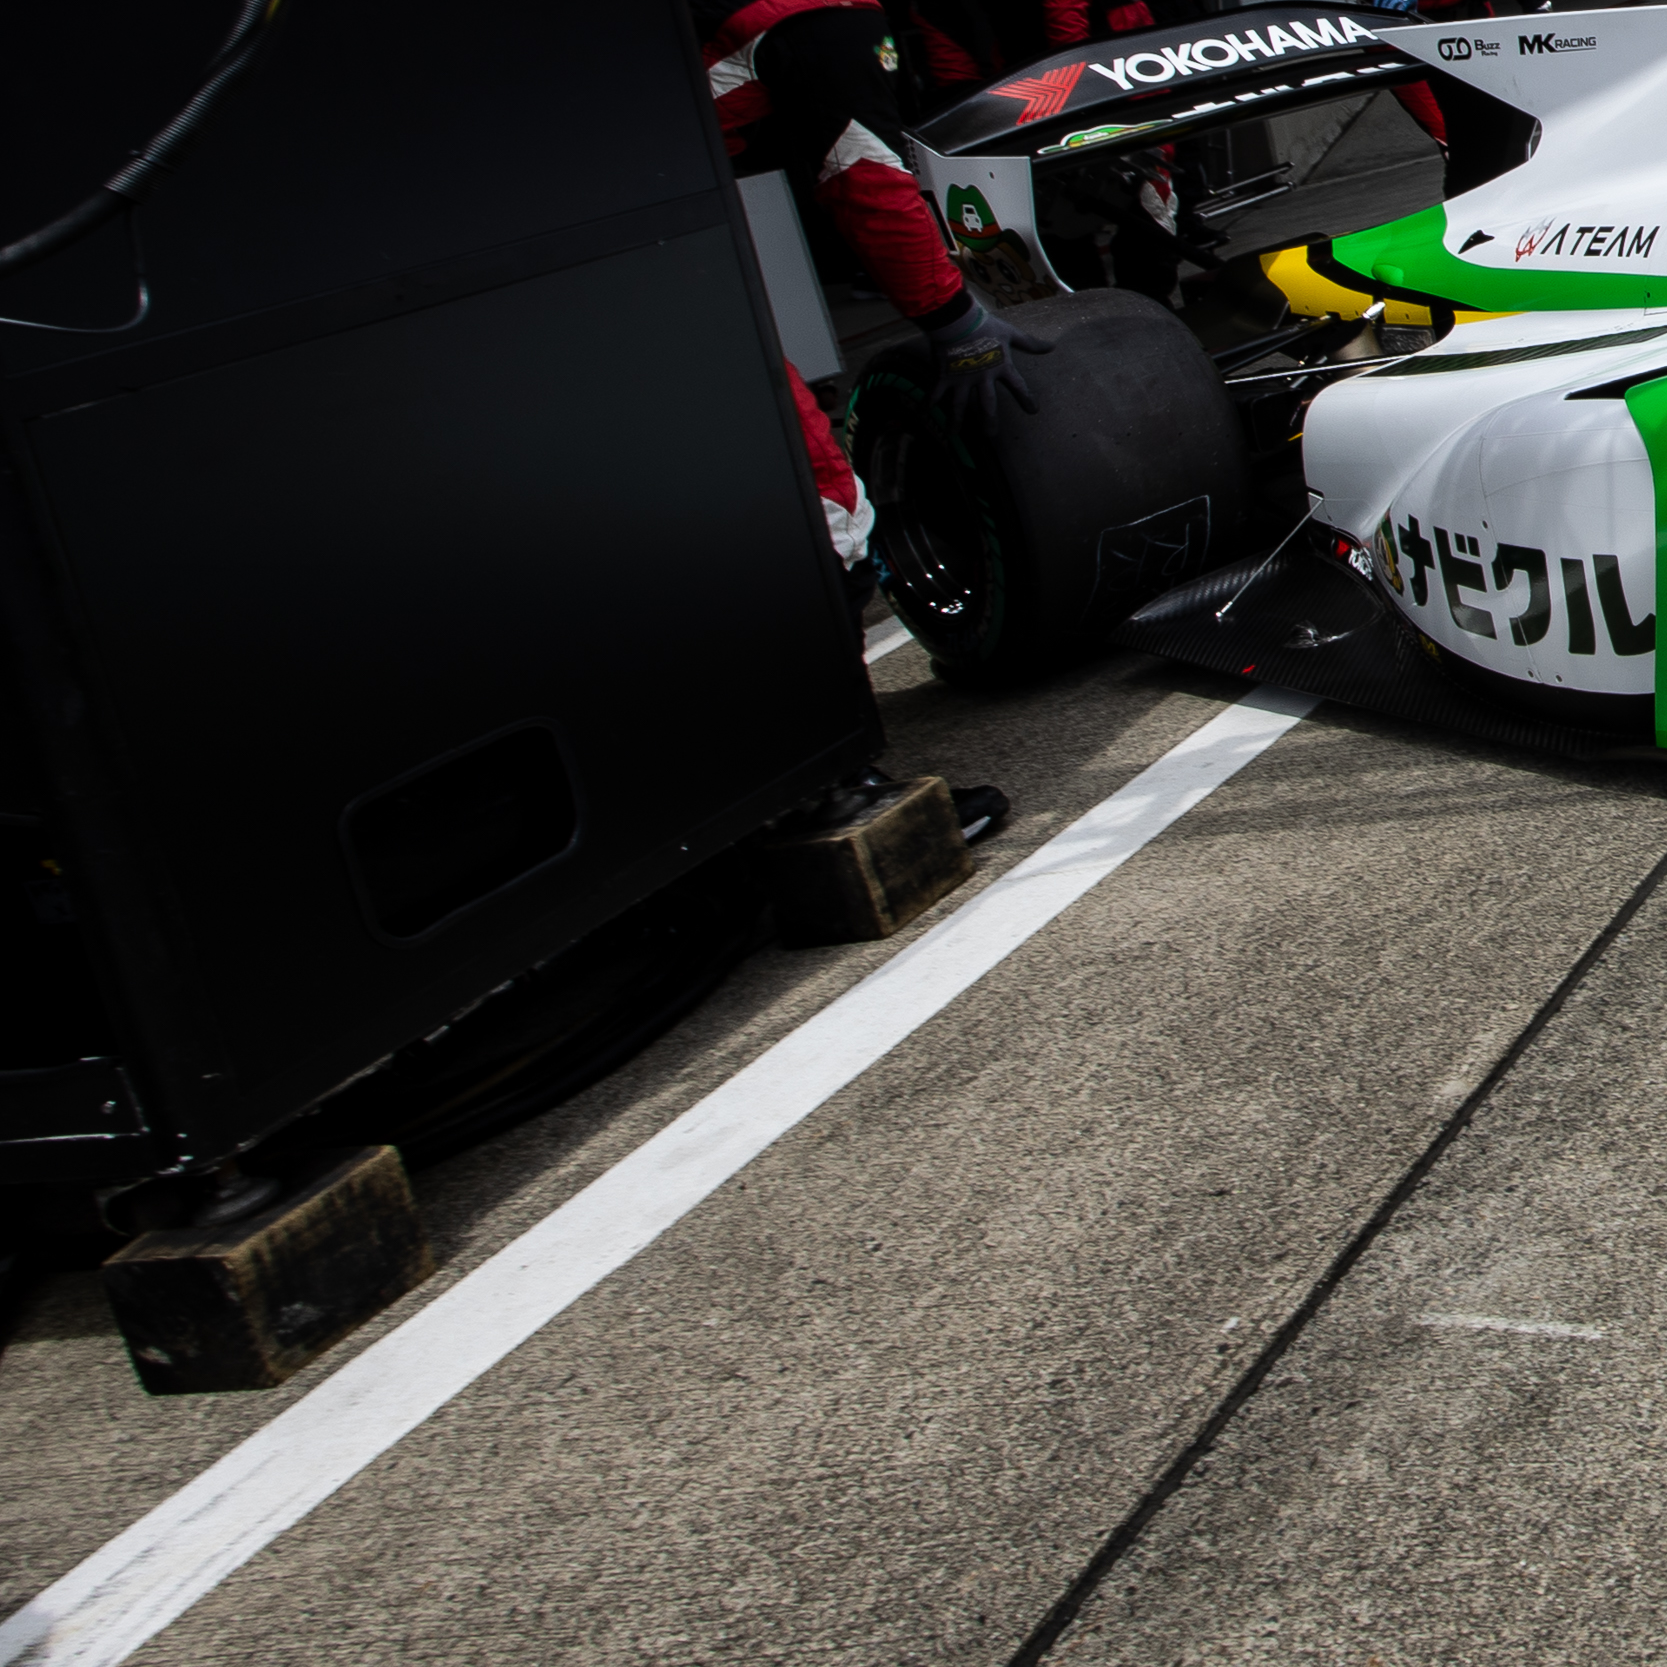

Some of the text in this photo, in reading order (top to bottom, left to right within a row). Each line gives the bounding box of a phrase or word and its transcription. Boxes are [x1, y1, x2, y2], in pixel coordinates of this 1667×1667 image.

[1089, 16, 1382, 91] YOKOHAMA
[1474, 39, 1501, 51] Buzz
[1518, 33, 1597, 55] MK RACING
[1540, 222, 1660, 258] ATEAM
[1396, 513, 1657, 657] ナビクル
